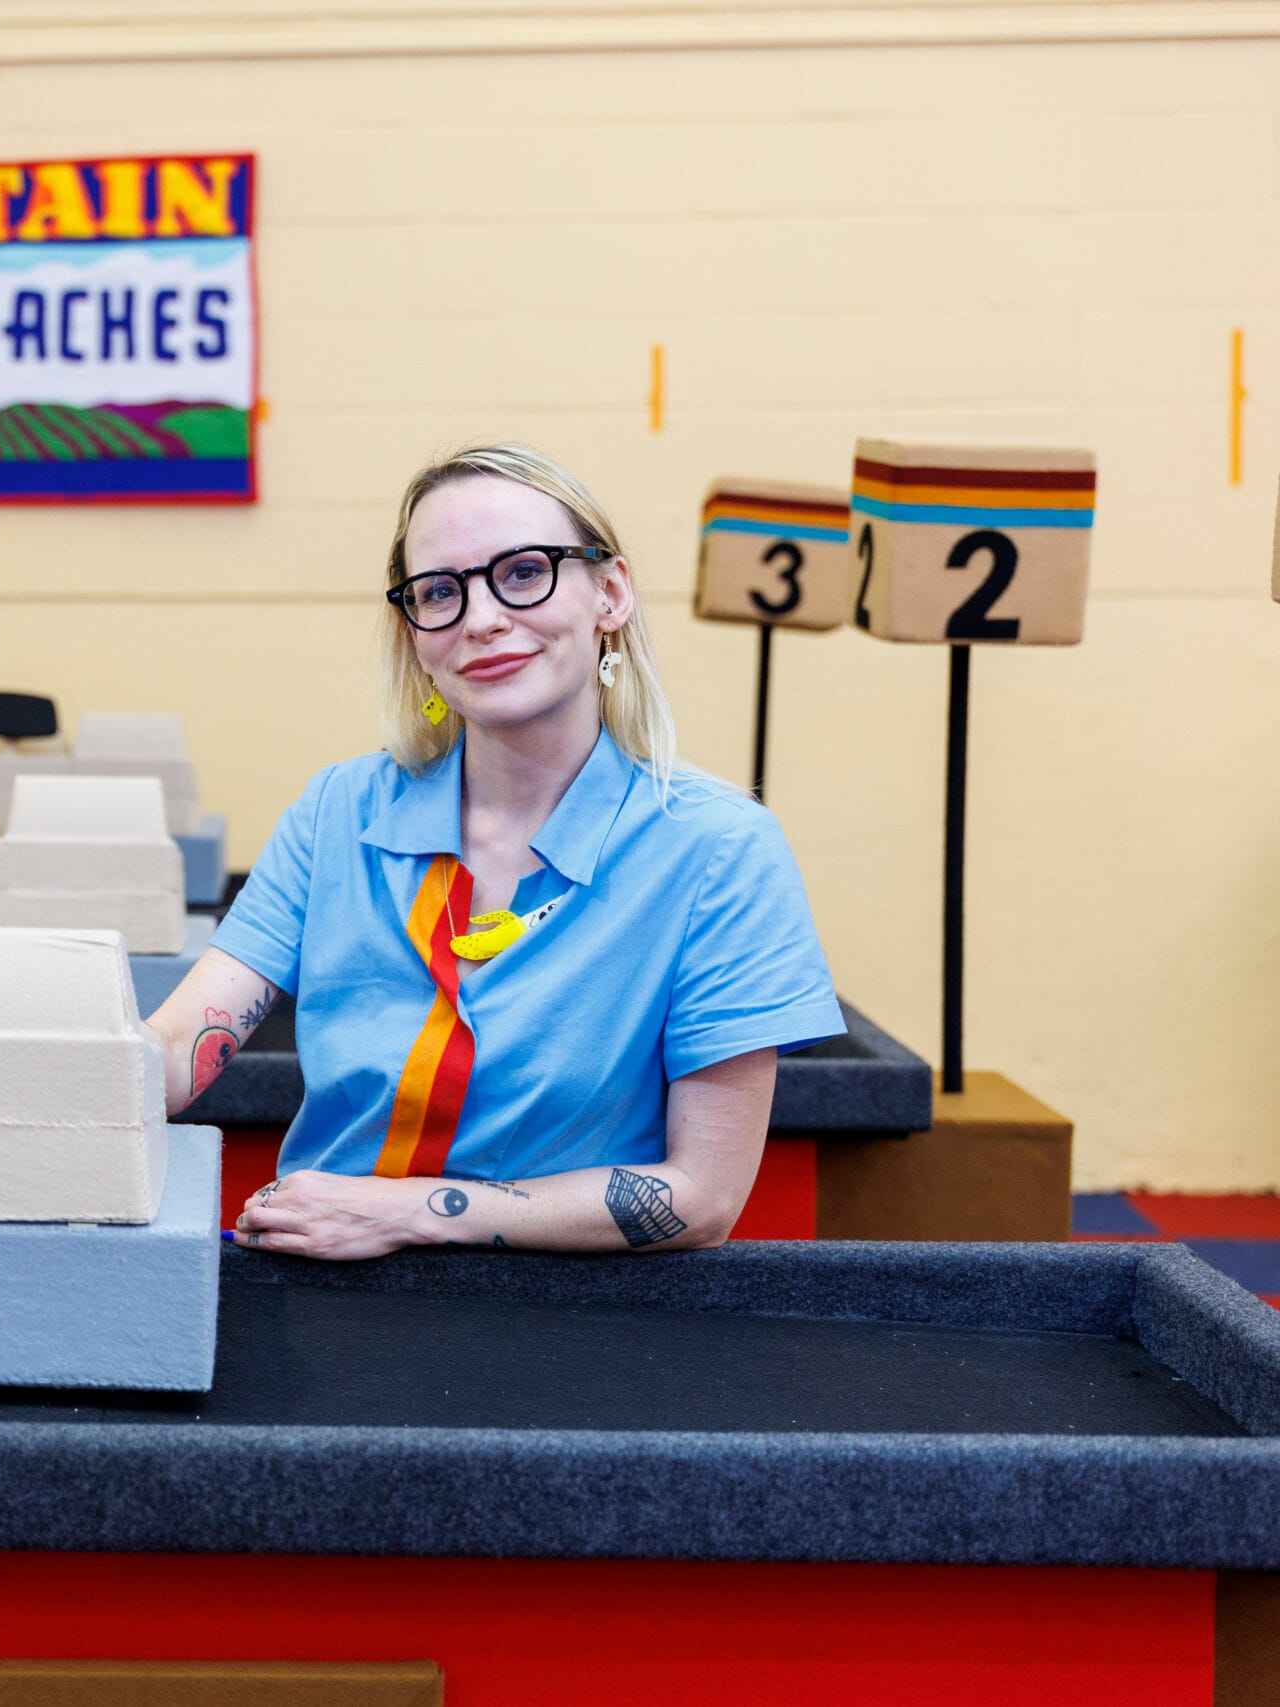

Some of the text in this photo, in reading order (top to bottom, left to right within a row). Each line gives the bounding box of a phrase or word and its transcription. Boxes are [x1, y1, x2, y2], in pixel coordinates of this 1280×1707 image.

[747, 539, 804, 616] 3
[855, 522, 873, 630] 2
[944, 529, 1020, 640] 2
